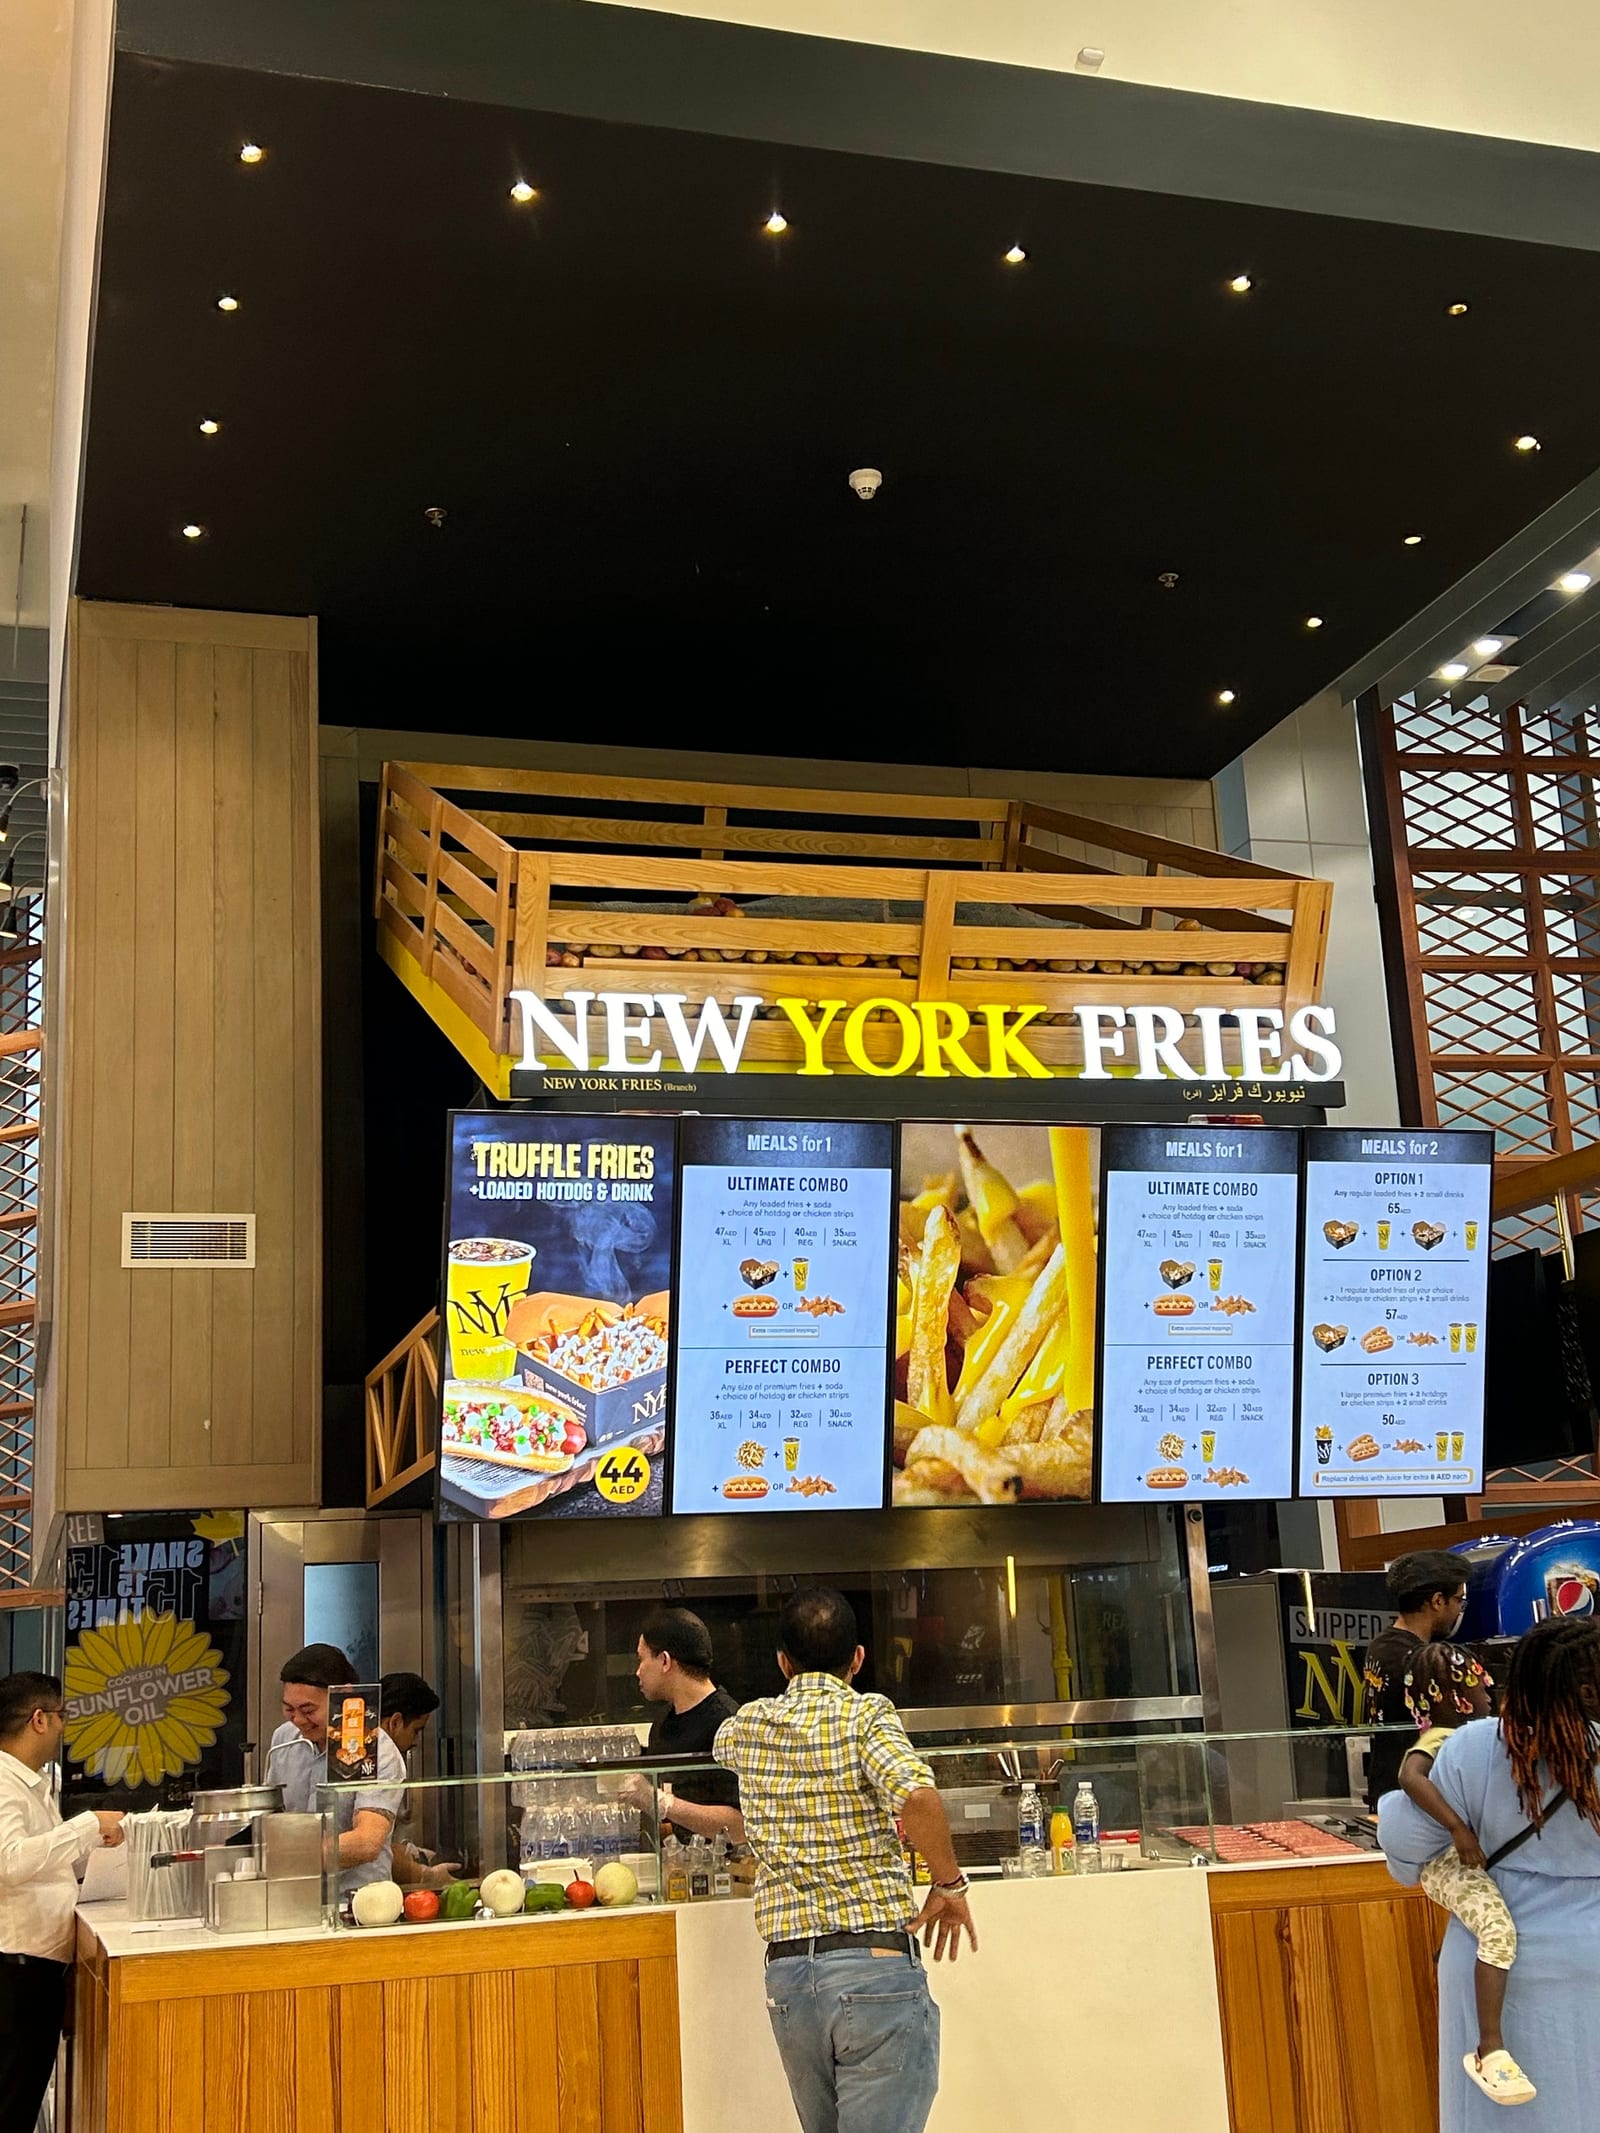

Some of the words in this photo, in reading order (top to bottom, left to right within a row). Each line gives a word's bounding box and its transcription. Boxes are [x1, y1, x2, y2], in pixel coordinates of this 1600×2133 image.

[509, 989, 764, 1074] NEW
[776, 998, 1056, 1079] YORK
[1073, 1005, 1344, 1082] FRIES
[543, 1077, 577, 1090] NEW
[579, 1078, 619, 1090] YORK
[622, 1079, 662, 1091] FRIES
[664, 1083, 696, 1093] (Branch)
[1208, 1082, 1244, 1102] فرايز
[1248, 1082, 1305, 1103] نيويورك
[747, 1134, 798, 1151] MEALS
[802, 1135, 823, 1152] for
[825, 1137, 831, 1152] 1
[1166, 1141, 1212, 1157] MEALS
[1216, 1142, 1236, 1158] for
[1237, 1144, 1242, 1158] 1
[1362, 1139, 1406, 1155] MEALS
[1410, 1140, 1427, 1155] for
[1429, 1141, 1438, 1156] 2
[473, 1141, 582, 1178] TRUFFLE
[587, 1144, 655, 1180] FRIES
[728, 1177, 795, 1191] ULTIMATE
[799, 1178, 848, 1192] COMBO
[1375, 1173, 1416, 1185] OPTION
[1419, 1173, 1423, 1185] 1
[469, 1181, 533, 1200] +LOADED
[536, 1182, 592, 1201] HOTDOG
[597, 1183, 608, 1201] &
[612, 1183, 654, 1202] DRINK
[1148, 1181, 1209, 1195] ULTIMATE
[1213, 1182, 1258, 1196] COMBO
[743, 1200, 758, 1209] Any
[759, 1200, 785, 1208] loaded
[787, 1200, 804, 1208] fries
[728, 1209, 753, 1217] choice
[764, 1210, 791, 1218] hotdog
[833, 1210, 854, 1219] strips
[1371, 1269, 1411, 1281] OPTION
[1415, 1270, 1422, 1281] 2
[782, 1303, 793, 1311] OR
[725, 1360, 788, 1374] PERFECT
[792, 1359, 841, 1373] COMBO
[1147, 1356, 1204, 1369] PERFECT
[1207, 1355, 1252, 1369] COMBO
[1368, 1373, 1408, 1386] OPTION
[1411, 1373, 1419, 1385] 3
[721, 1383, 736, 1392] Any
[764, 1383, 797, 1391] premium
[1363, 1391, 1392, 1399] premium
[759, 1392, 785, 1401] hotdog
[829, 1392, 849, 1400] strips
[600, 1456, 643, 1483] 44
[1322, 1475, 1348, 1483] Replace
[610, 1486, 635, 1495] AED
[1295, 1611, 1381, 1640] SHIPPED
[107, 1670, 152, 1688] COOKED
[155, 1667, 167, 1677] IN
[65, 1668, 213, 1719] SUNFLOWER
[124, 1702, 164, 1725] OIL
